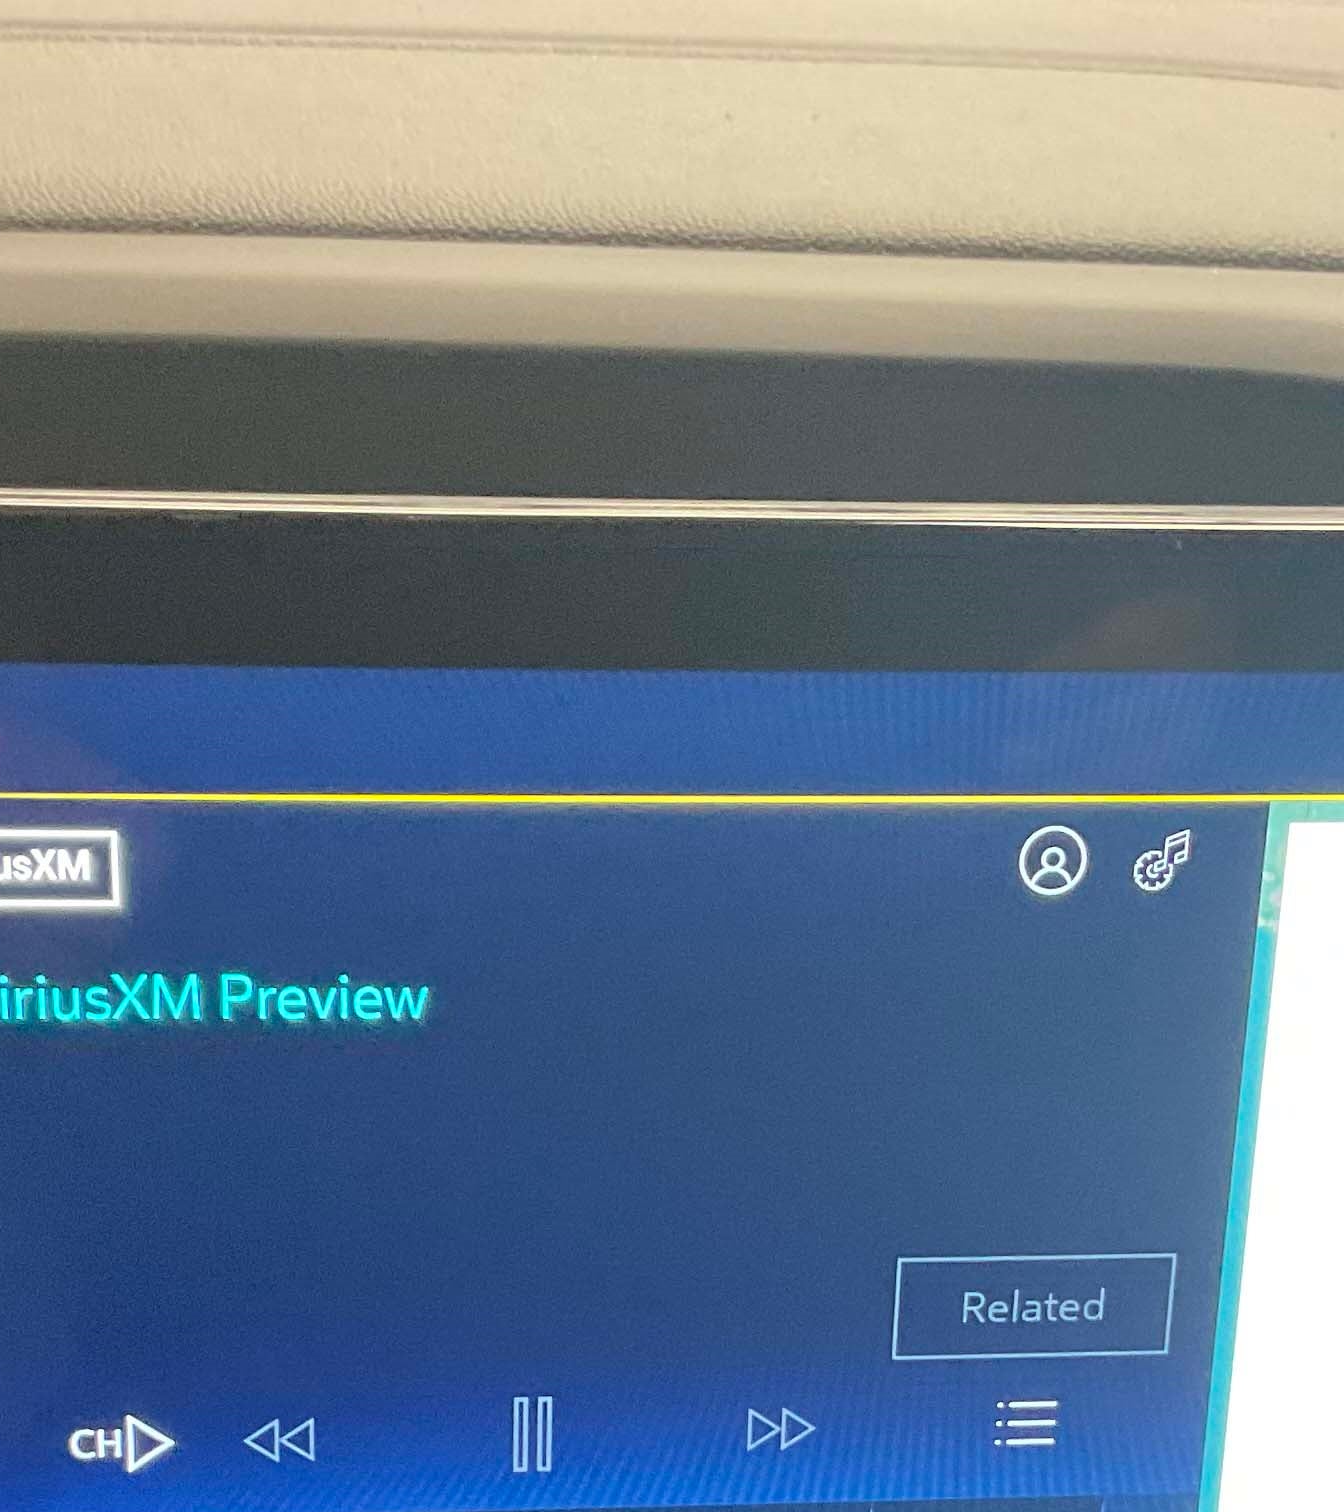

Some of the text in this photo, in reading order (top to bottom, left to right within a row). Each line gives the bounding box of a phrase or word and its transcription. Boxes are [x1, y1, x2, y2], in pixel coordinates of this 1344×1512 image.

[219, 973, 428, 1021] Preview
[962, 1287, 1105, 1323] Related
[69, 1428, 122, 1459] CH
